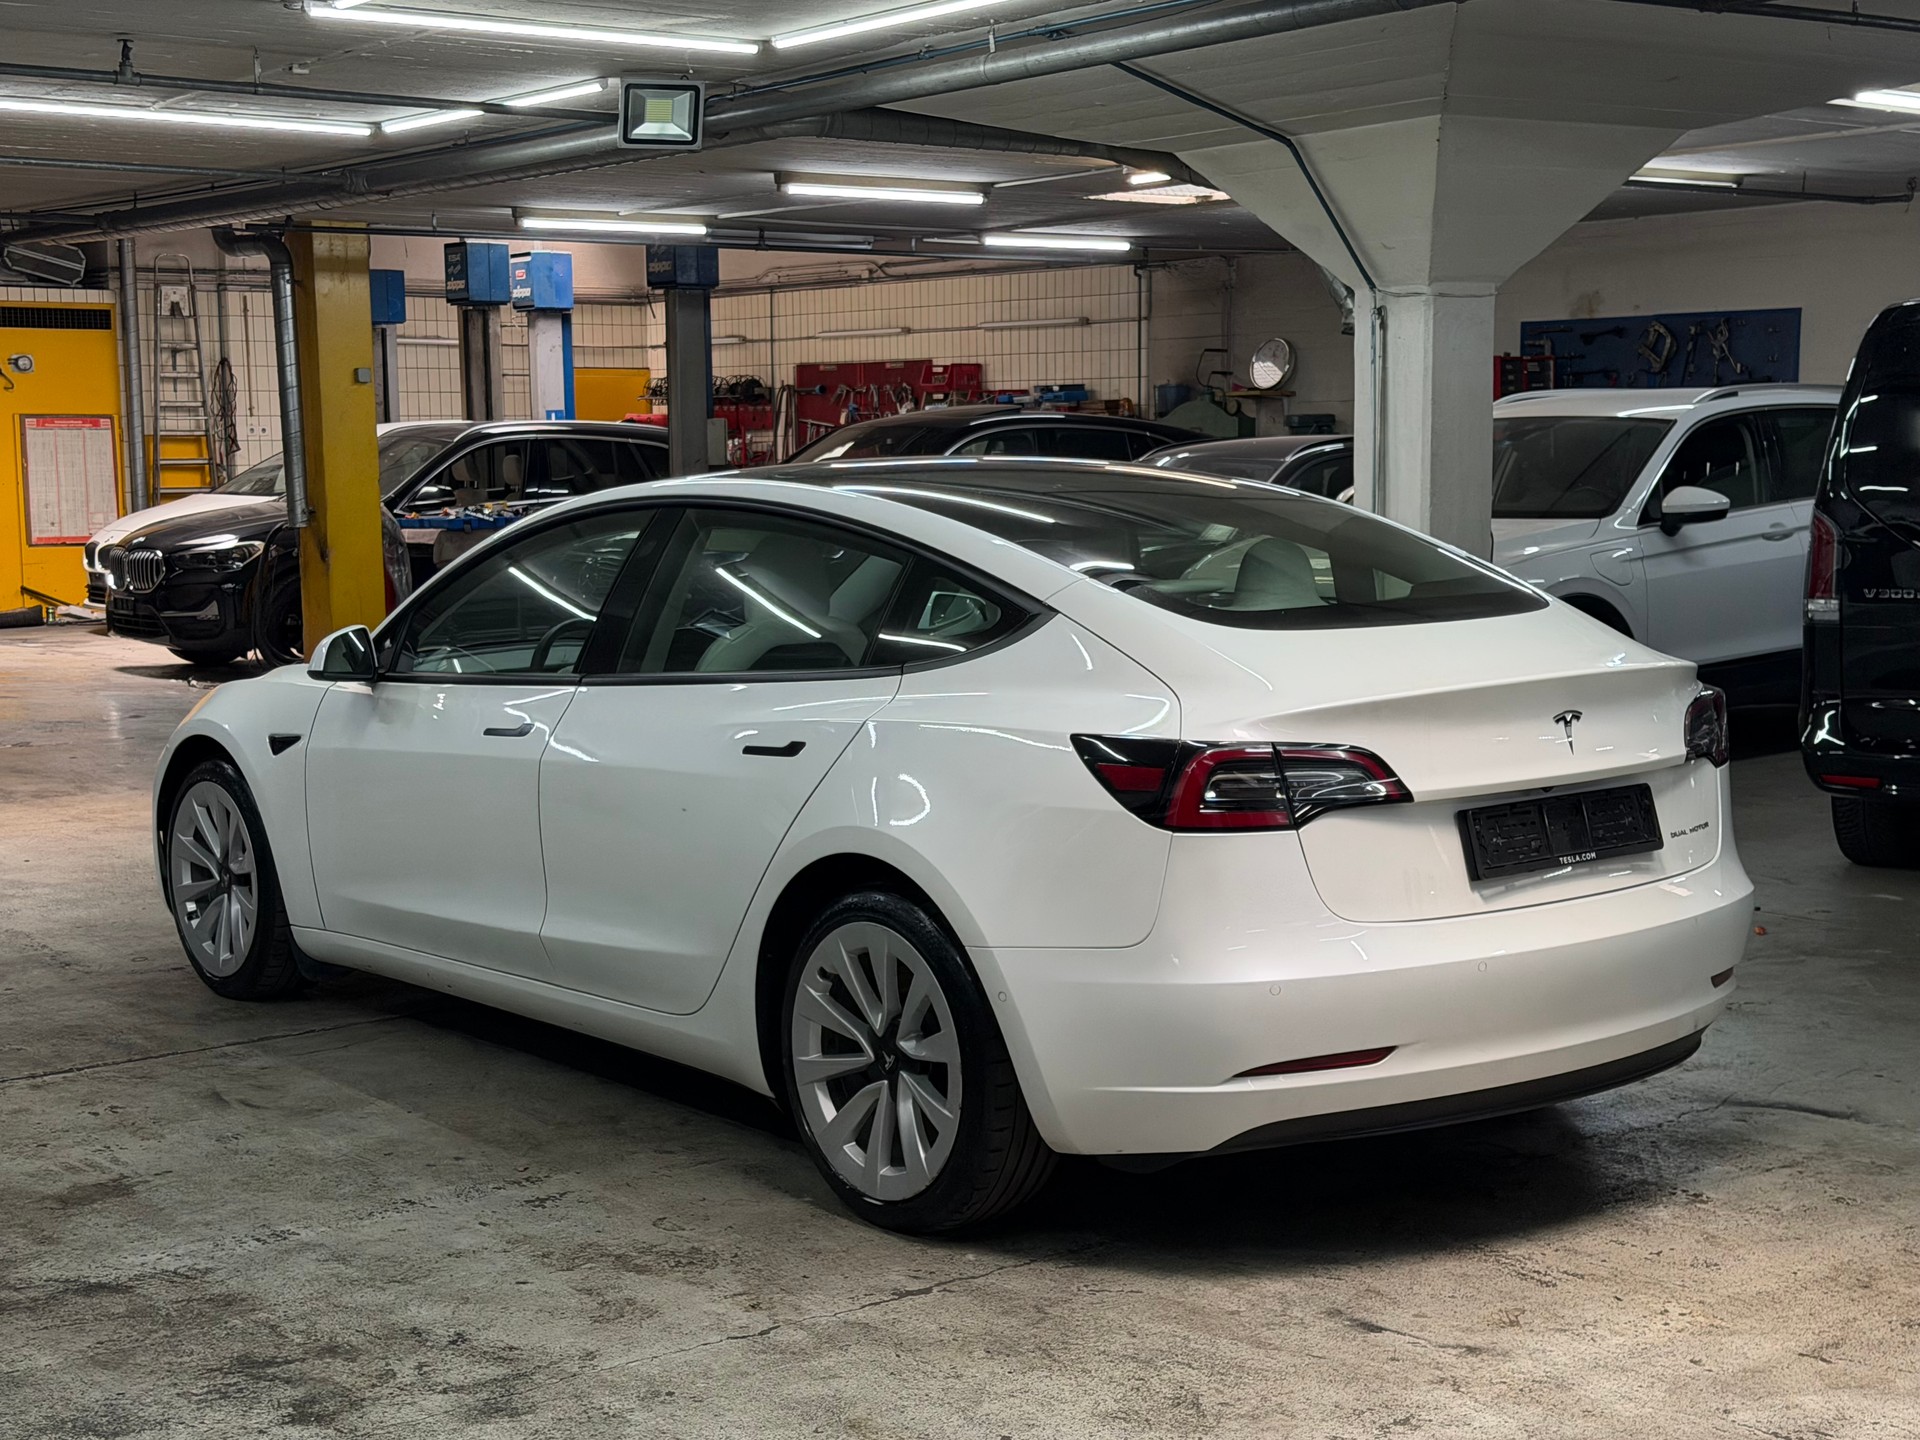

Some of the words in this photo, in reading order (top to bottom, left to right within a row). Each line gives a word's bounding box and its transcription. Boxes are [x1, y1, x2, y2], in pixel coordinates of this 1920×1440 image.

[1670, 829, 1688, 839] DUAL
[1689, 821, 1709, 834] MOTOR
[1559, 851, 1597, 865] TESLA.COM
